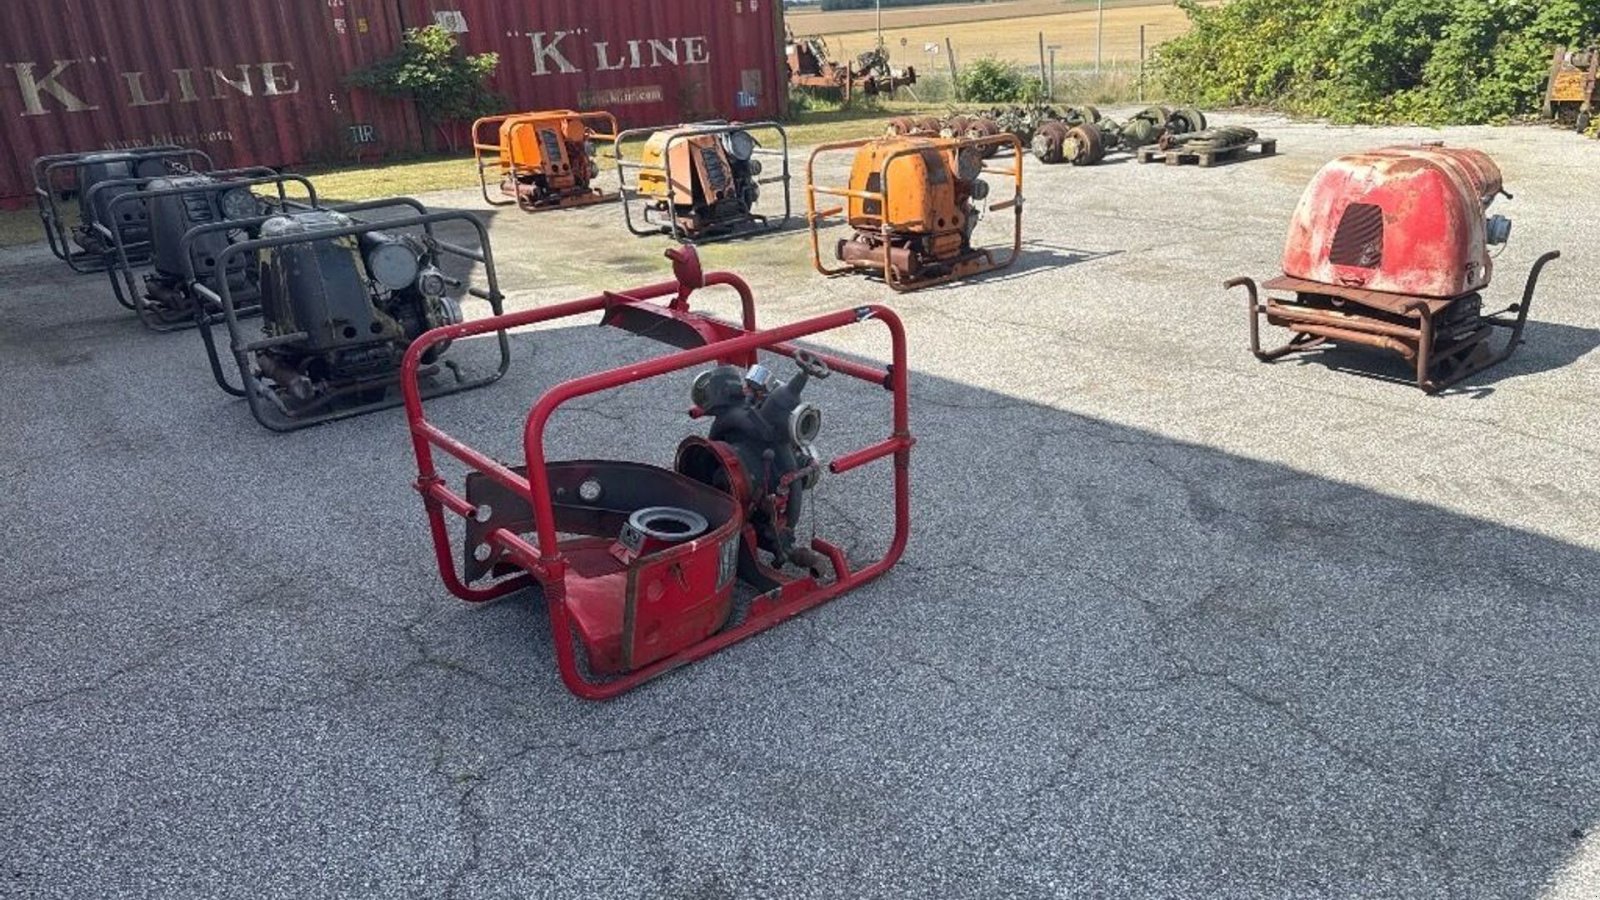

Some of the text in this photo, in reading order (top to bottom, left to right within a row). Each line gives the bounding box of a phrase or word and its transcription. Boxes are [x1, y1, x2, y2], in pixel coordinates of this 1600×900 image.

[593, 35, 710, 71] LINE
[120, 61, 299, 107] LINE
[349, 124, 376, 142] TIR
